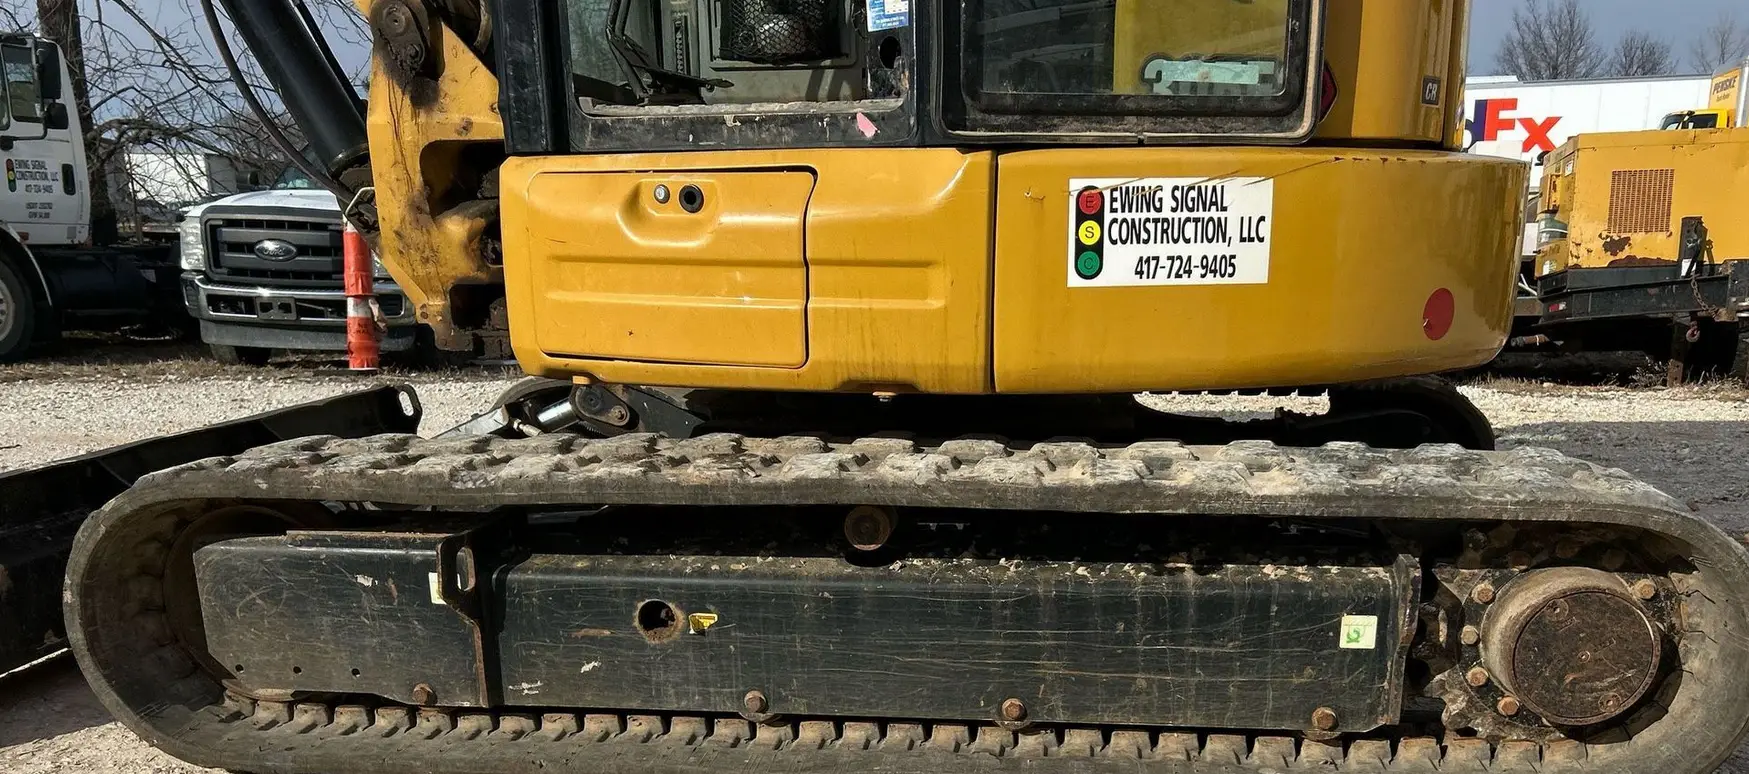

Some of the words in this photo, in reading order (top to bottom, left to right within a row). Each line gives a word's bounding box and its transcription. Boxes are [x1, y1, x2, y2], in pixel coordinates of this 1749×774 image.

[1425, 82, 1438, 101] CR
[1712, 75, 1738, 95] PENSKE
[15, 159, 31, 170] EWING
[31, 160, 48, 170] SIGNAL
[1085, 195, 1095, 209] E
[1109, 185, 1164, 214] EWING
[1170, 185, 1228, 213] SIGNAL
[1085, 225, 1095, 239] S
[1107, 216, 1233, 247] CONSTRUCTION,
[1239, 216, 1266, 243] LLC
[1134, 254, 1237, 280] 417-724-9405
